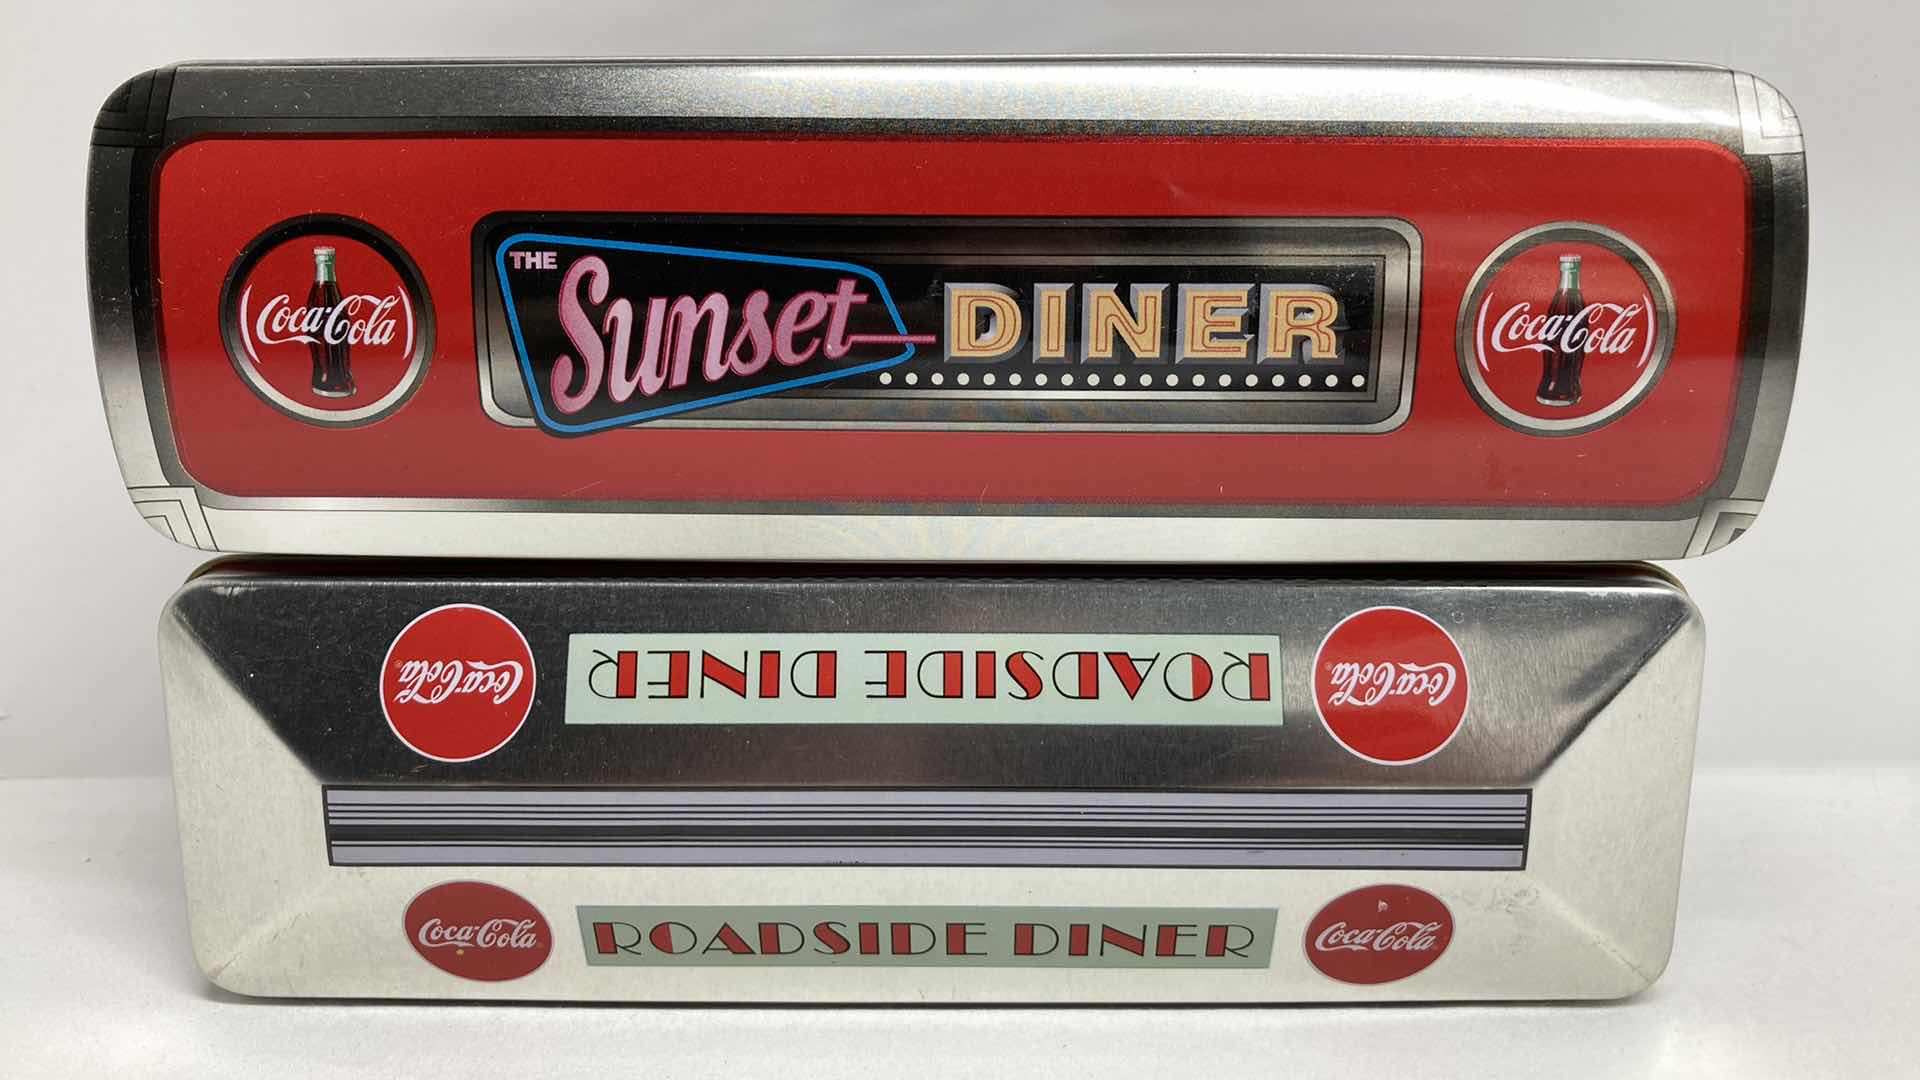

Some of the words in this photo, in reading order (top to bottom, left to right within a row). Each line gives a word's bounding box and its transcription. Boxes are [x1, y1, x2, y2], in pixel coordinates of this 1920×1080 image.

[508, 250, 558, 271] THE
[255, 293, 401, 346] Coca-Cola
[550, 255, 937, 414] Sunset
[943, 281, 1345, 365] DINER
[1491, 301, 1645, 354] Coca-Cola
[393, 659, 524, 705] Coca-Cola
[588, 648, 838, 700] DINER
[864, 648, 1271, 702] ROADSIDE
[1327, 661, 1457, 707] Coca-Cola
[417, 917, 537, 949] Coca-Cola
[592, 921, 989, 957] ROADSIDE
[1013, 922, 1255, 959] DINER
[1314, 920, 1443, 951] Coca-Cola
